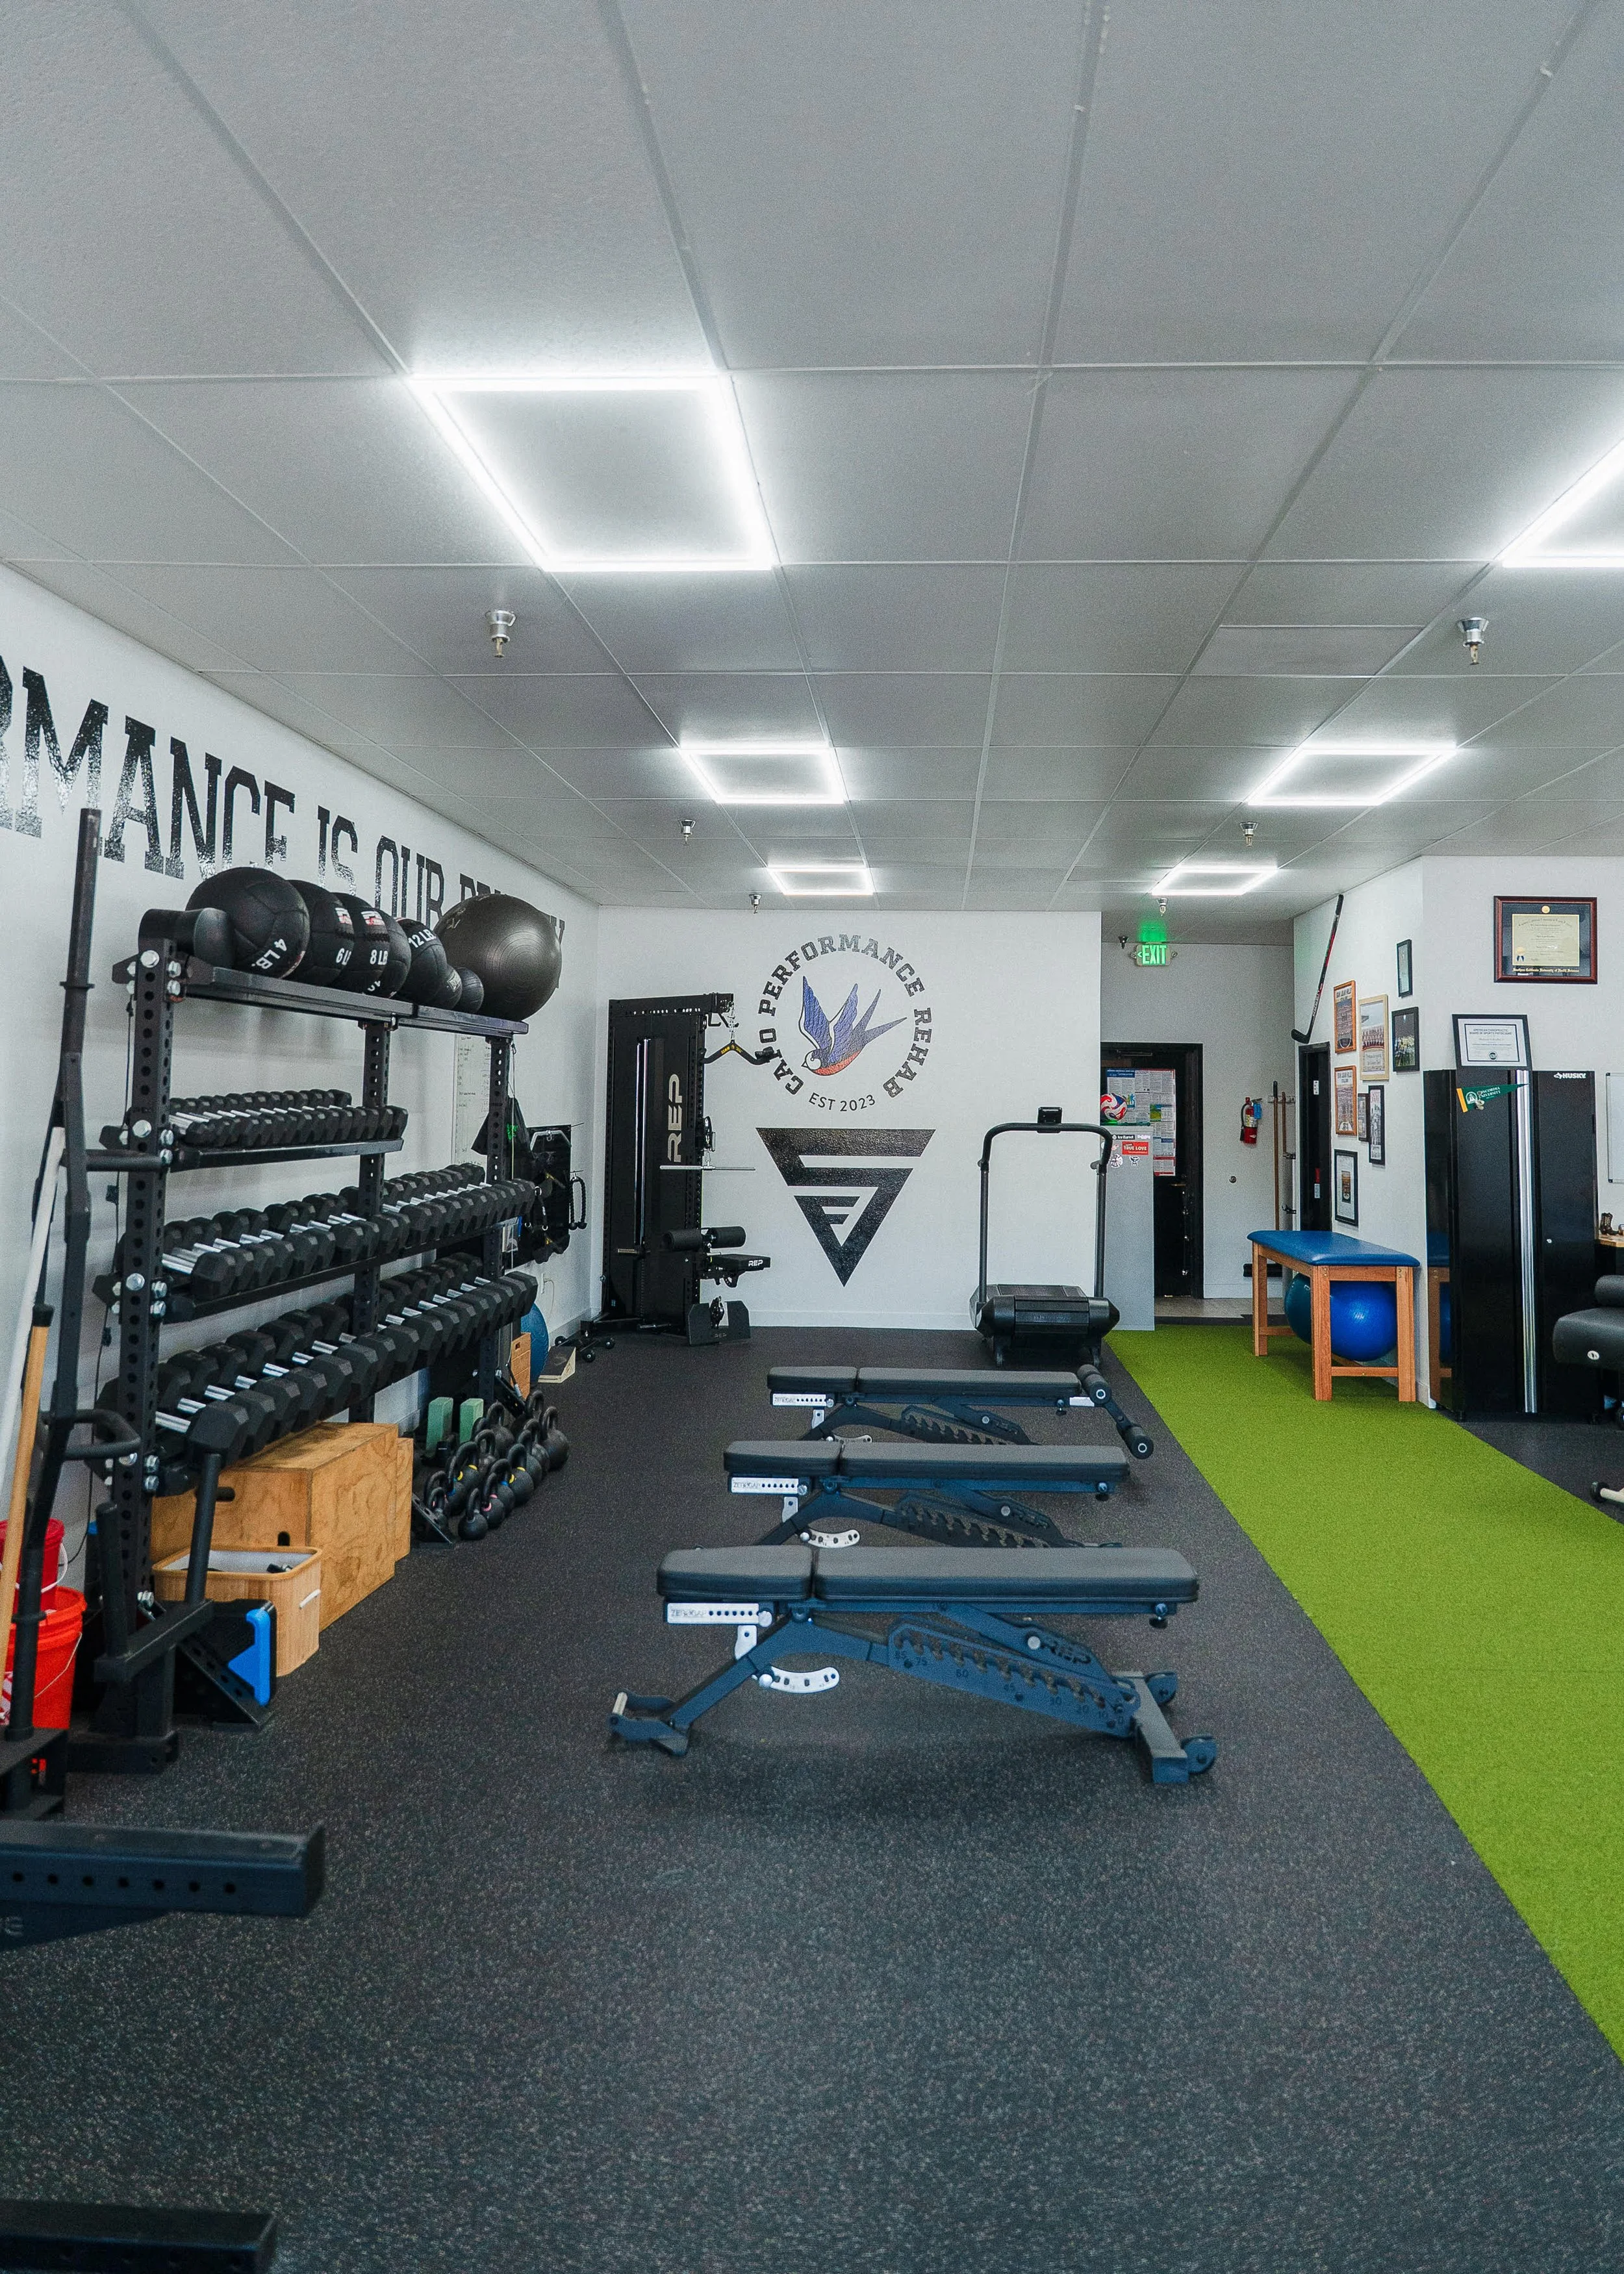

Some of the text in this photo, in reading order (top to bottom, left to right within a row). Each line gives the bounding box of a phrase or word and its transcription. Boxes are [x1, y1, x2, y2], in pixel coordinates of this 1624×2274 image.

[0, 655, 444, 930] MANCE IS OUR
[273, 939, 287, 952] 4
[408, 935, 424, 948] 12
[336, 948, 345, 963] 6
[370, 949, 377, 965] 8
[1142, 945, 1167, 964] EXIT
[758, 934, 932, 1098] CAO PERFORMANCE REHAB
[808, 1093, 876, 1112] EST 2023
[667, 1074, 683, 1163] REP
